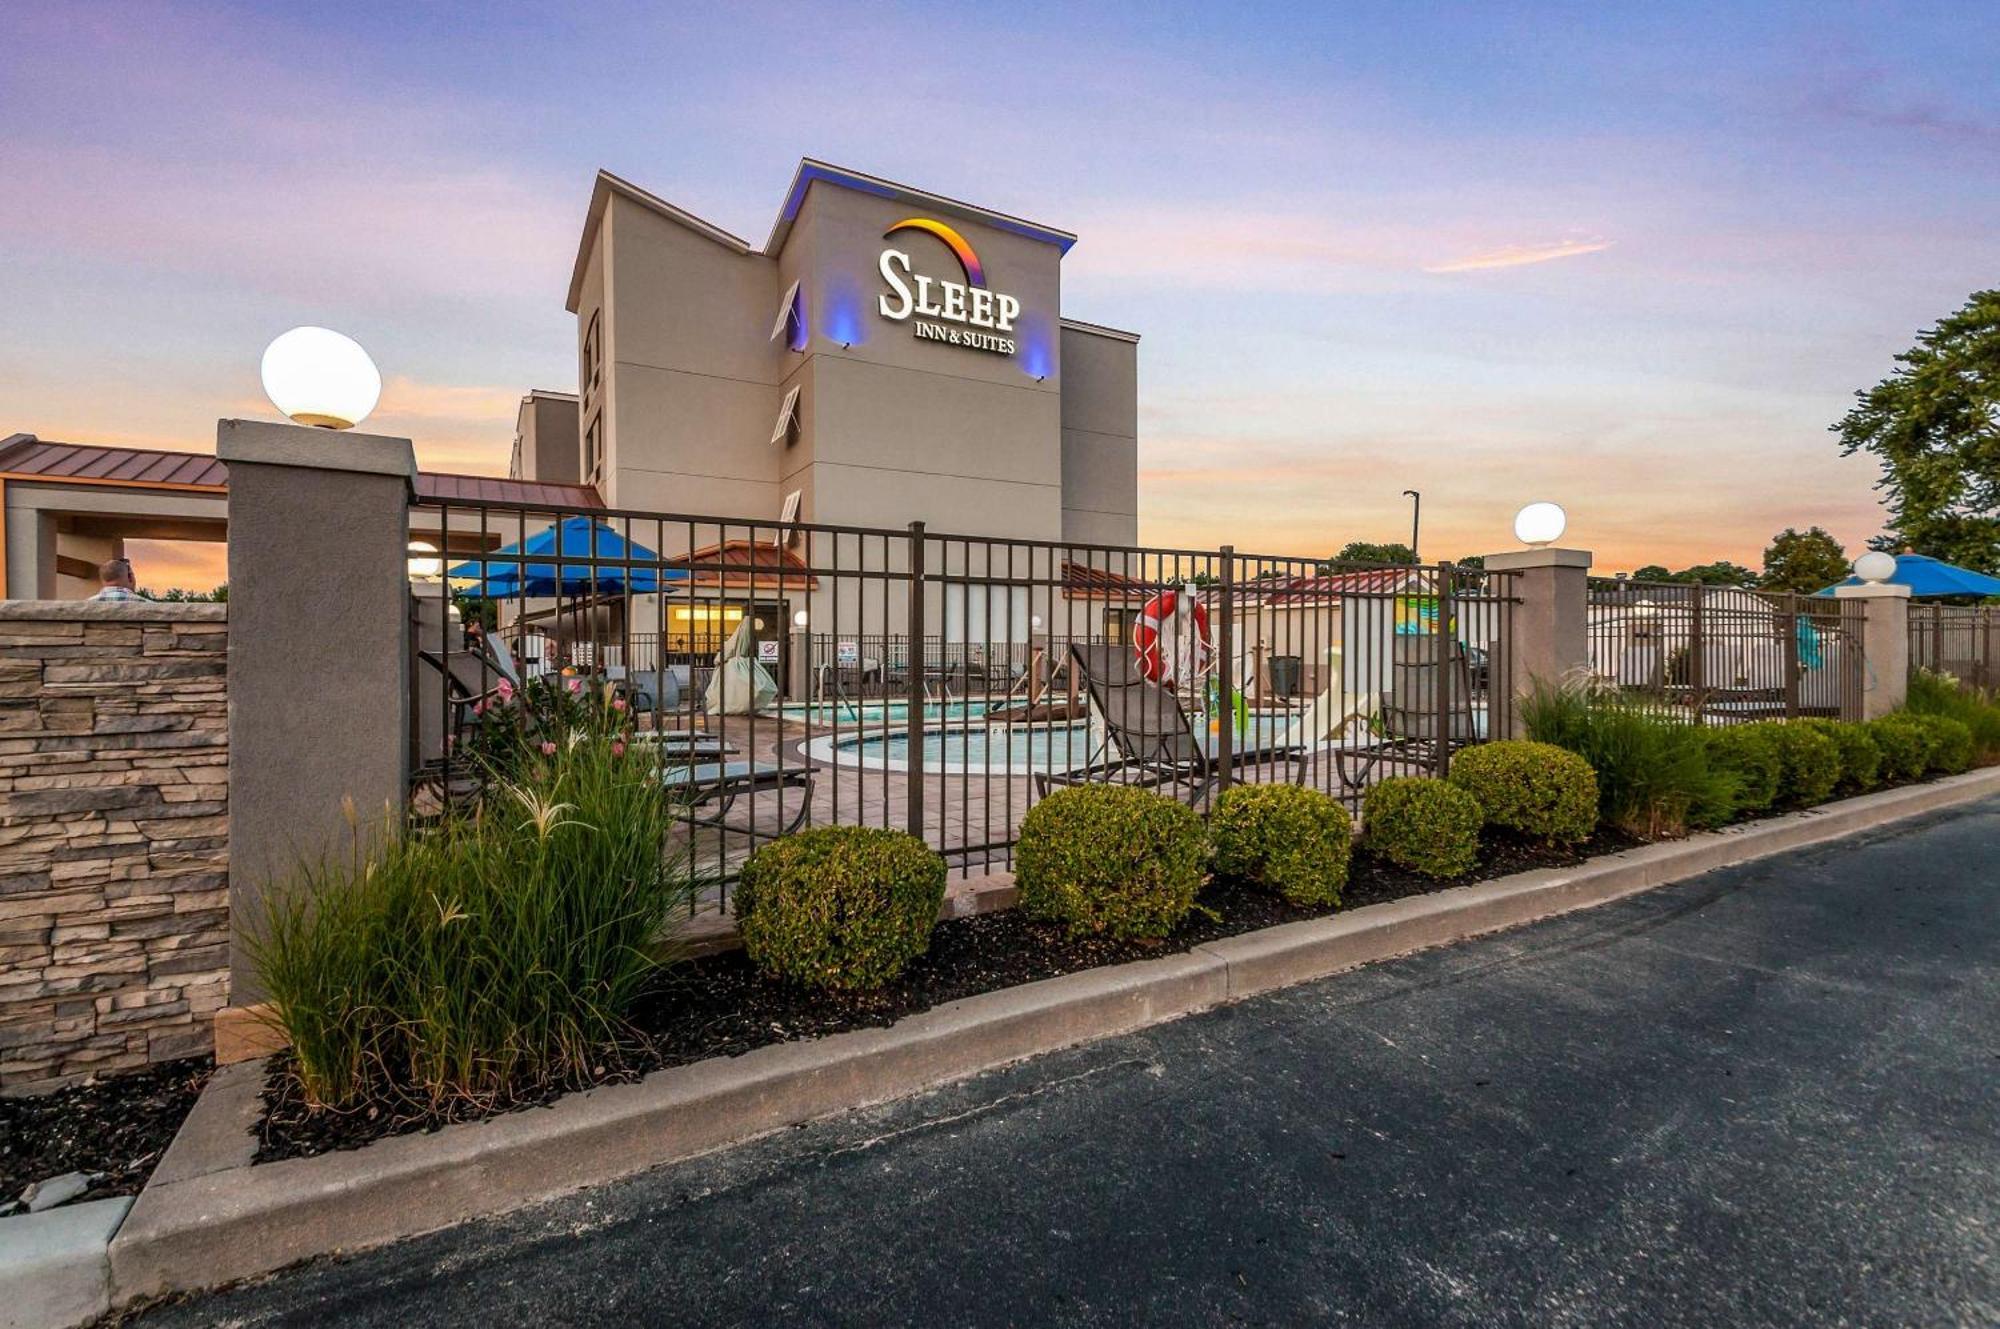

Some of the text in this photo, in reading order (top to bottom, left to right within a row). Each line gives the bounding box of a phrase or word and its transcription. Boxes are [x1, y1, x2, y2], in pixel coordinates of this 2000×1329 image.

[879, 249, 1020, 331] SLEEP
[915, 321, 1015, 354] INN & SUITES
